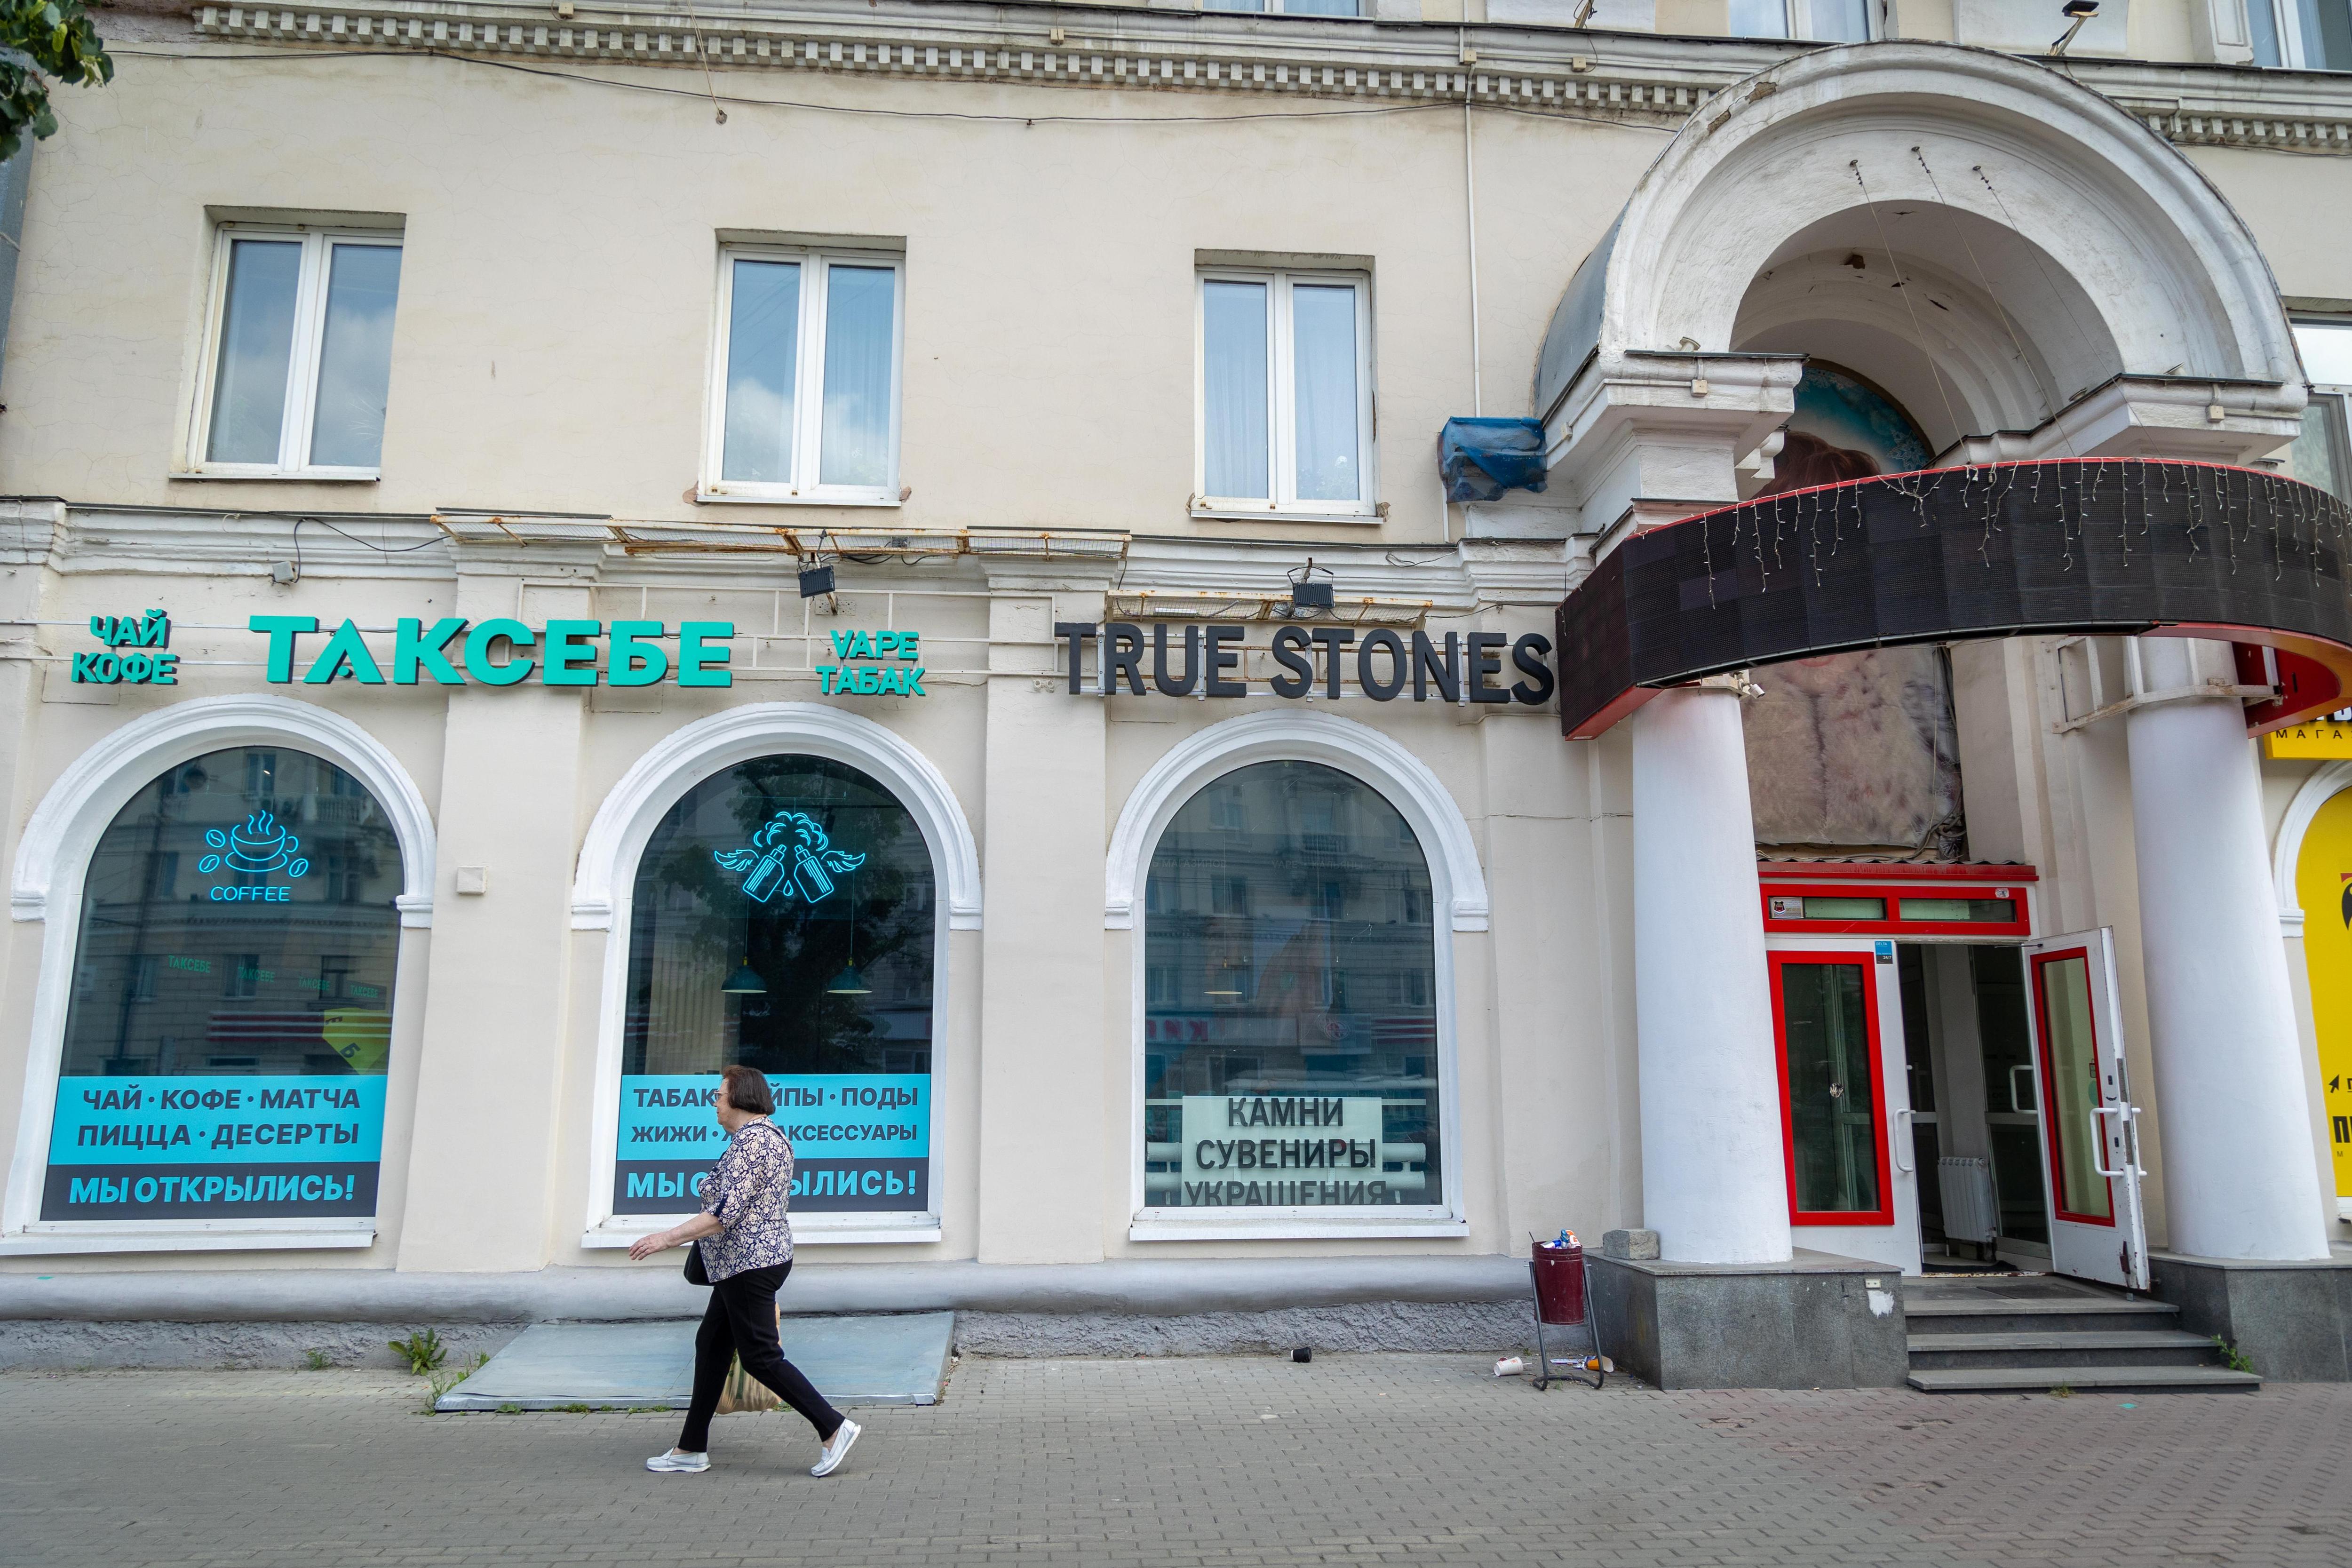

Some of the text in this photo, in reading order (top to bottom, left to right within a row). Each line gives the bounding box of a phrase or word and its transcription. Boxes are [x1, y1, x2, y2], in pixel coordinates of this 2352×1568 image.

[90, 609, 171, 648] ЧАЙ
[249, 615, 735, 688] ТАКСЕБЕ
[830, 630, 919, 661] VAPE
[71, 652, 181, 685] КОФЕ
[1054, 622, 1556, 706] TRUE STONES
[815, 666, 926, 697] ТАБАК
[2276, 729, 2352, 739] МАГА
[210, 886, 292, 901] COFFEE
[168, 955, 211, 973] ТАКСЕБЕ
[83, 1084, 360, 1110] ЧАЙ КОФЕ МАТЧА
[841, 1087, 918, 1110] ПОДЫ
[1228, 1098, 1343, 1127] КАМНИ
[77, 1123, 359, 1150] ПИЦЦА ДЕСЕРТЫ
[630, 1126, 707, 1142] ЖИЖИ
[1196, 1138, 1376, 1170] СУВЕНИРЫ
[69, 1174, 355, 1203] МЫ ОТКРЫЛИСЬ!
[627, 1172, 684, 1198] МЫ
